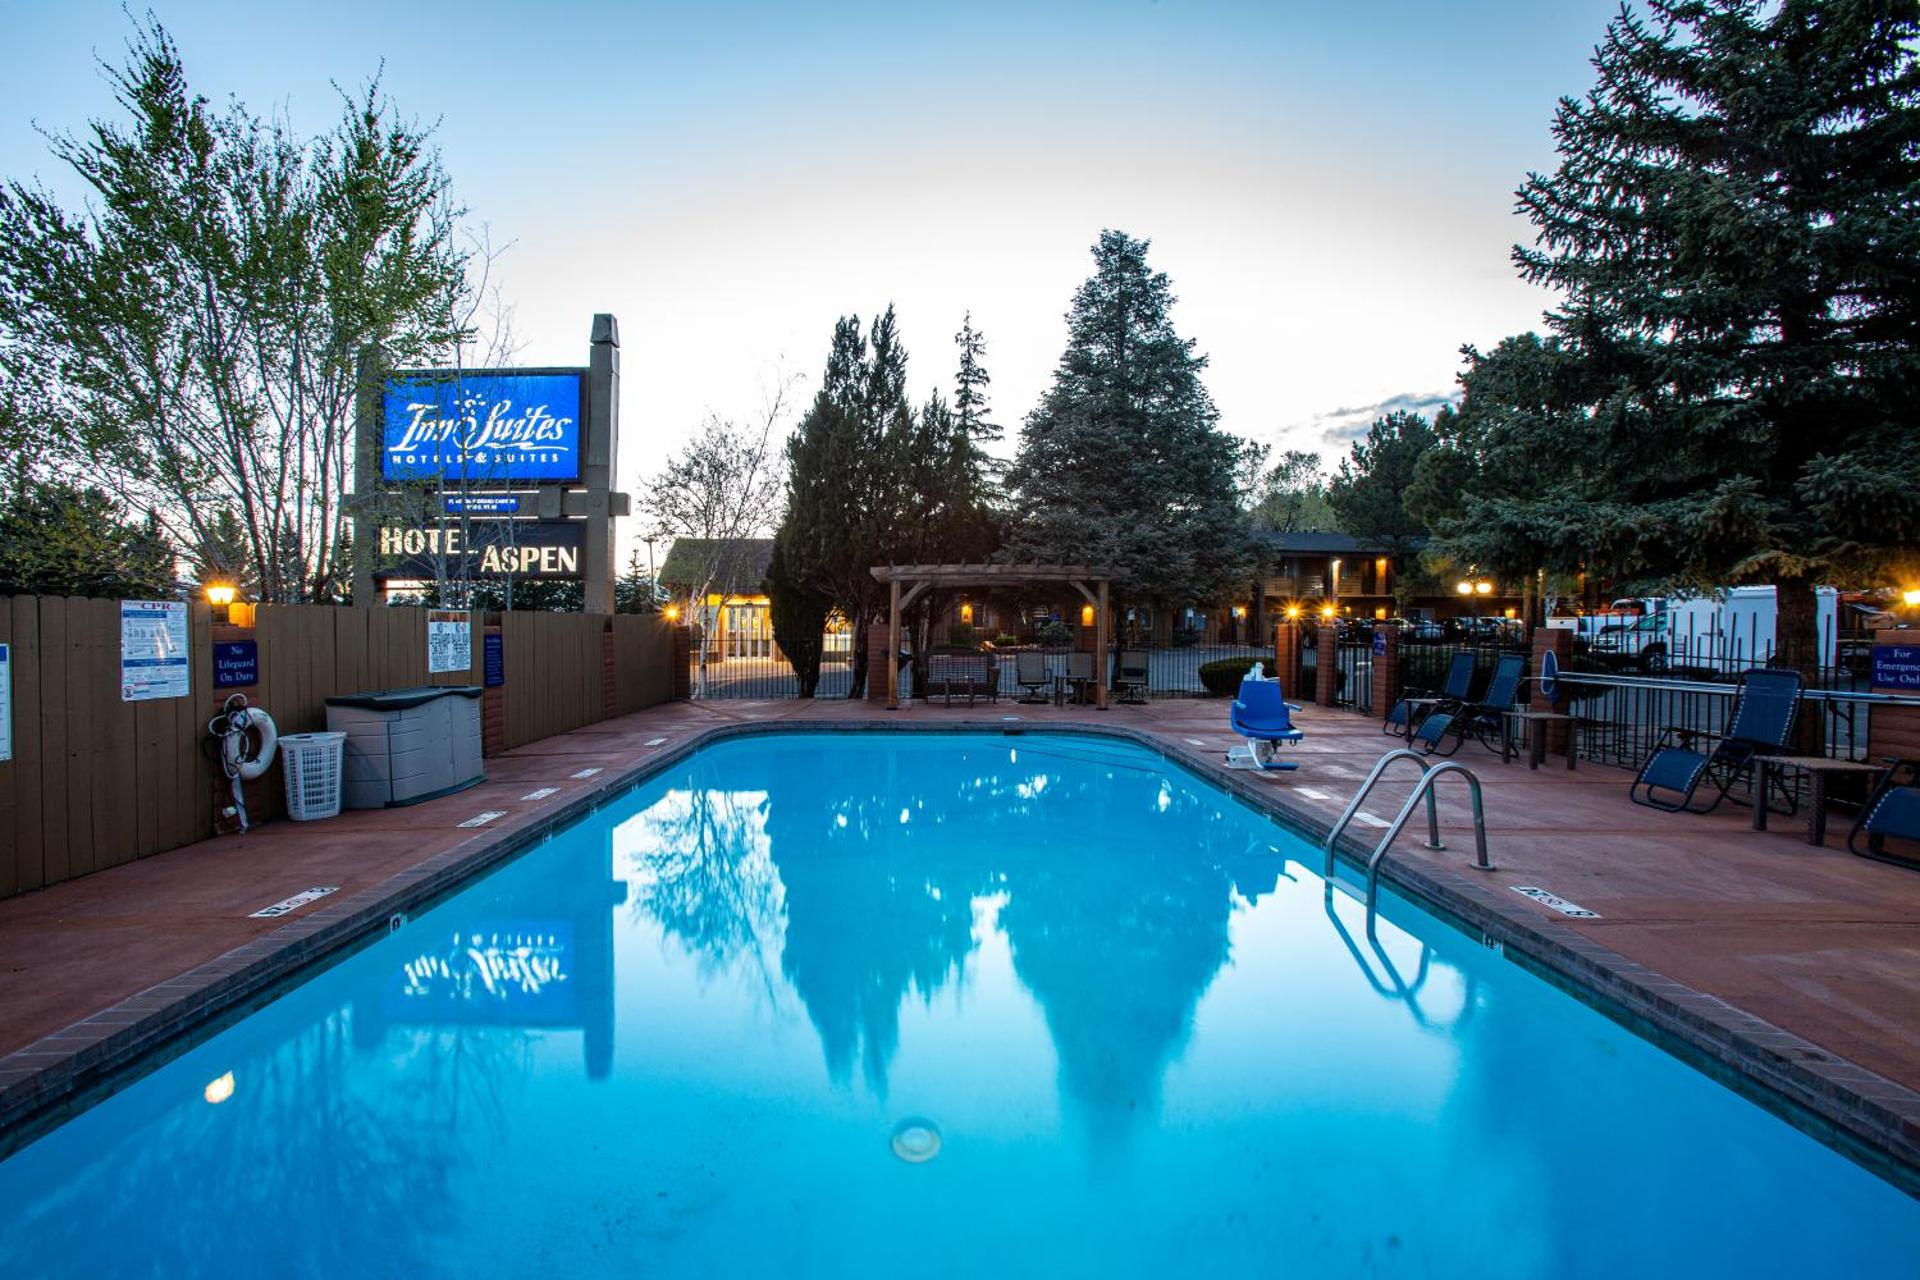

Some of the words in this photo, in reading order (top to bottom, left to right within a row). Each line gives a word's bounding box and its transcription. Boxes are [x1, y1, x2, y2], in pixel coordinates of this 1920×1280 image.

[392, 455, 463, 464] HOTELS
[474, 452, 487, 463] &
[494, 454, 559, 463] SUITES
[380, 526, 479, 555] HOTEL
[480, 545, 577, 573] ASPEN
[141, 602, 171, 610] CPR
[230, 646, 243, 655] No
[1894, 648, 1912, 658] For
[218, 657, 254, 670] Lifeguard
[220, 671, 233, 682] On
[235, 671, 253, 682] Duty
[1877, 672, 1896, 682] Use
